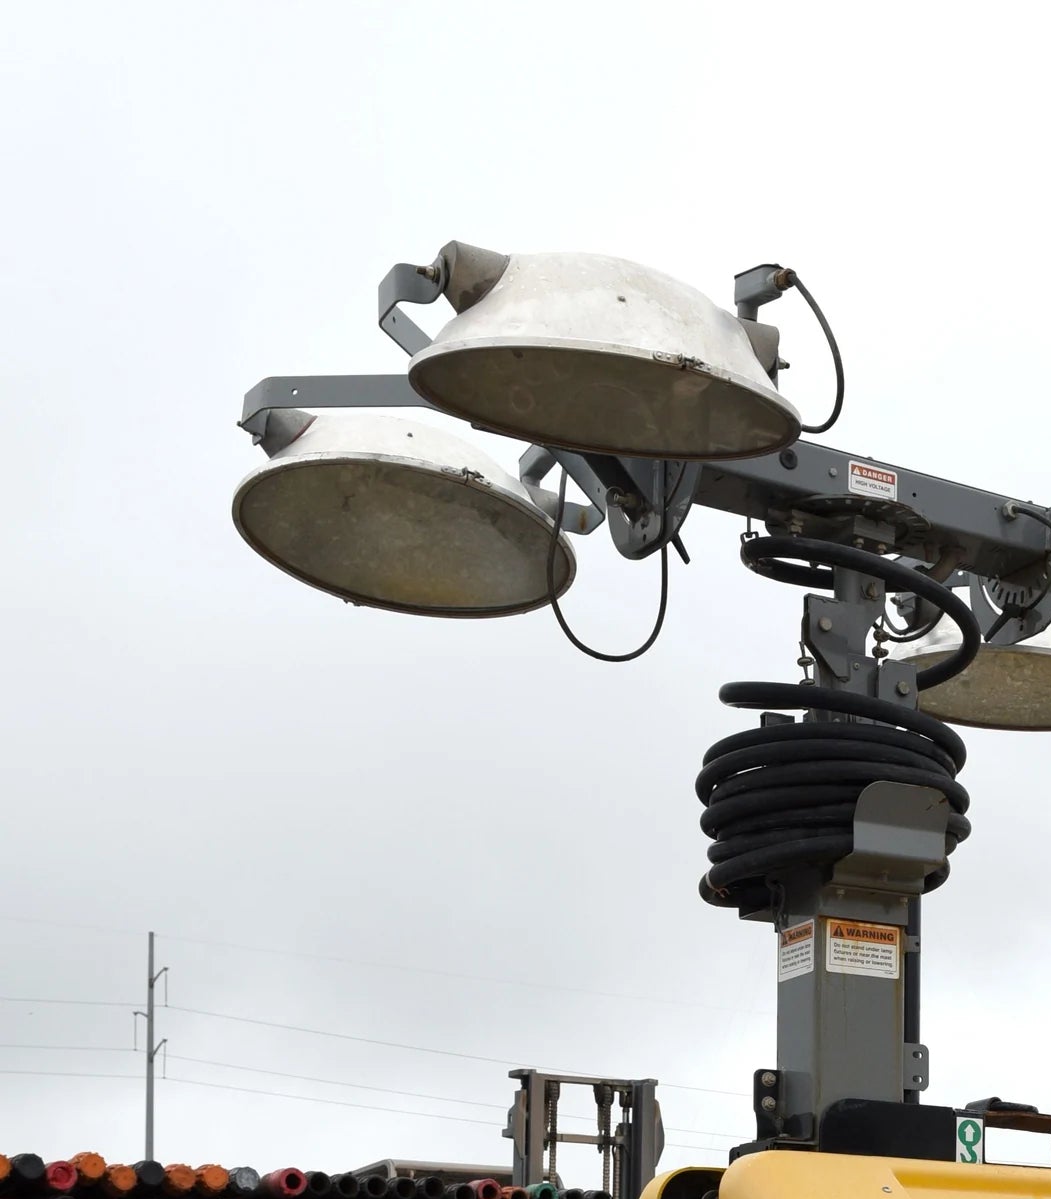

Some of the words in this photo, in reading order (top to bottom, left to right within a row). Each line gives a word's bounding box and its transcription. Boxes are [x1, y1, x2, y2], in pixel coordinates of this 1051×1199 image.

[862, 469, 893, 483] DANGER
[855, 479, 868, 487] HIGH
[869, 483, 891, 492] VOLTAGE
[846, 927, 895, 942] WARNING
[872, 960, 892, 968] lowering
